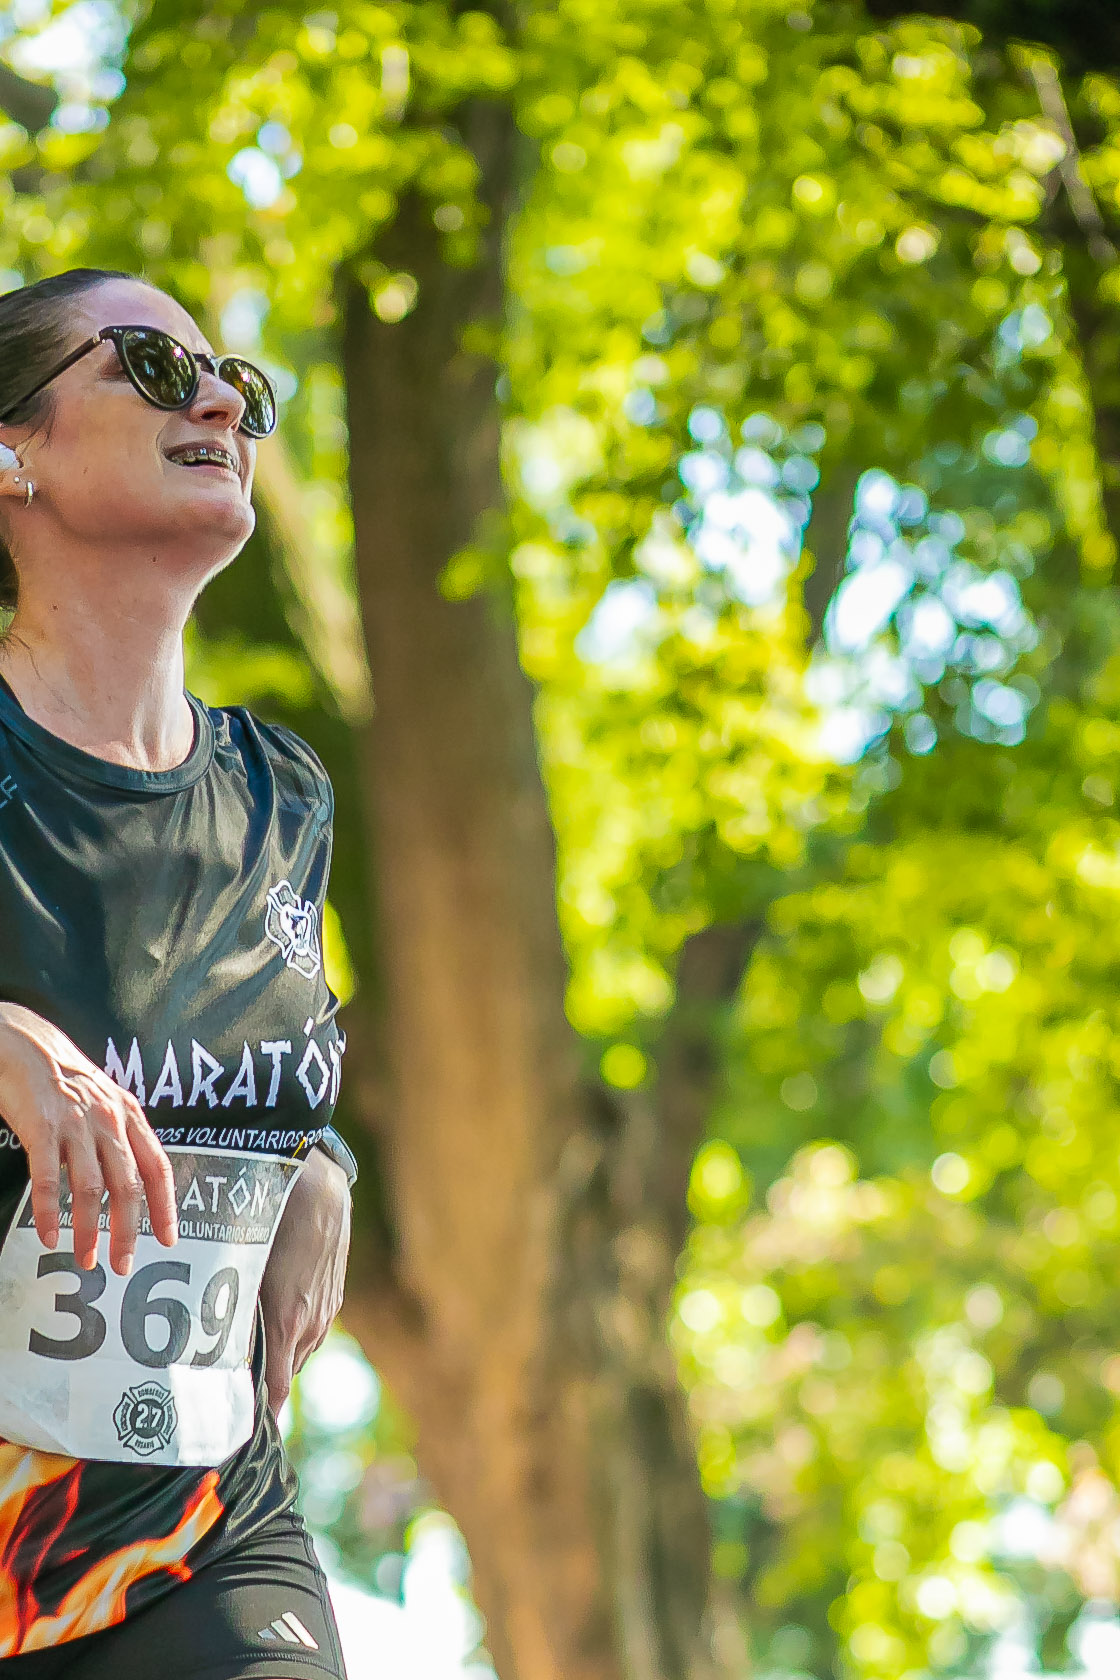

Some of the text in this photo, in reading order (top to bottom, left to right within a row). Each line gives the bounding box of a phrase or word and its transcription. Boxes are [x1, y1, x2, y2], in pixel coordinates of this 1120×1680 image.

[186, 1127, 304, 1150] VOLUNTARIOS
[178, 1216, 246, 1244] OLUNTARIOS
[29, 1251, 240, 1370] 369
[135, 1403, 162, 1429] 27
